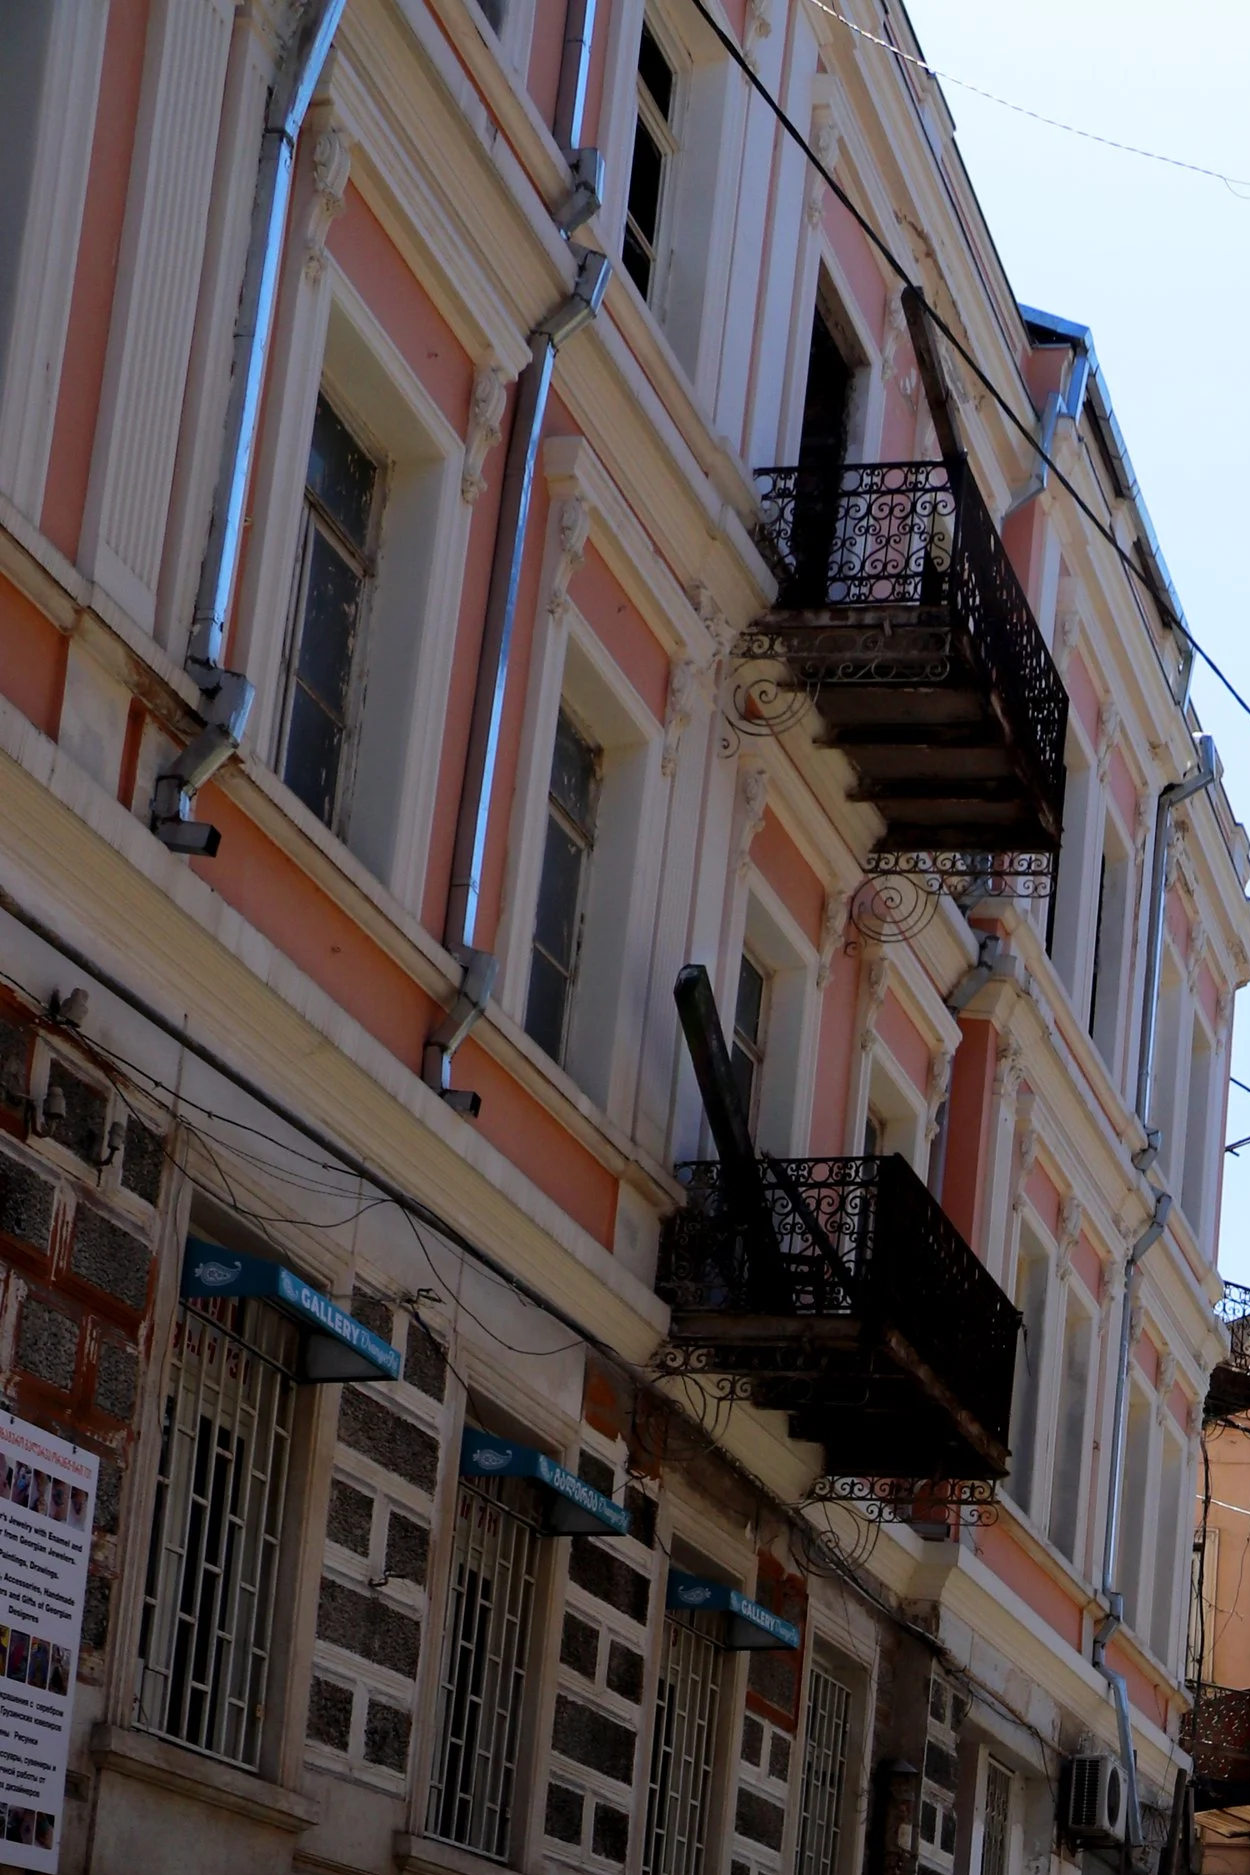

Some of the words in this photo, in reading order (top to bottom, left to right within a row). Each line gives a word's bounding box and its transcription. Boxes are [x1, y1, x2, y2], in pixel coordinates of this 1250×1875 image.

[301, 1287, 360, 1345] GALLERY
[19, 1535, 47, 1553] Georgian
[34, 1526, 47, 1538] with
[48, 1531, 70, 1548] Enamel
[71, 1544, 83, 1553] and
[4, 1572, 42, 1596] Accessories,
[43, 1587, 75, 1607] Handmade
[9, 1591, 21, 1601] and
[38, 1601, 45, 1610] of
[45, 1603, 72, 1621] Georgian
[741, 1599, 776, 1632] GALLERY
